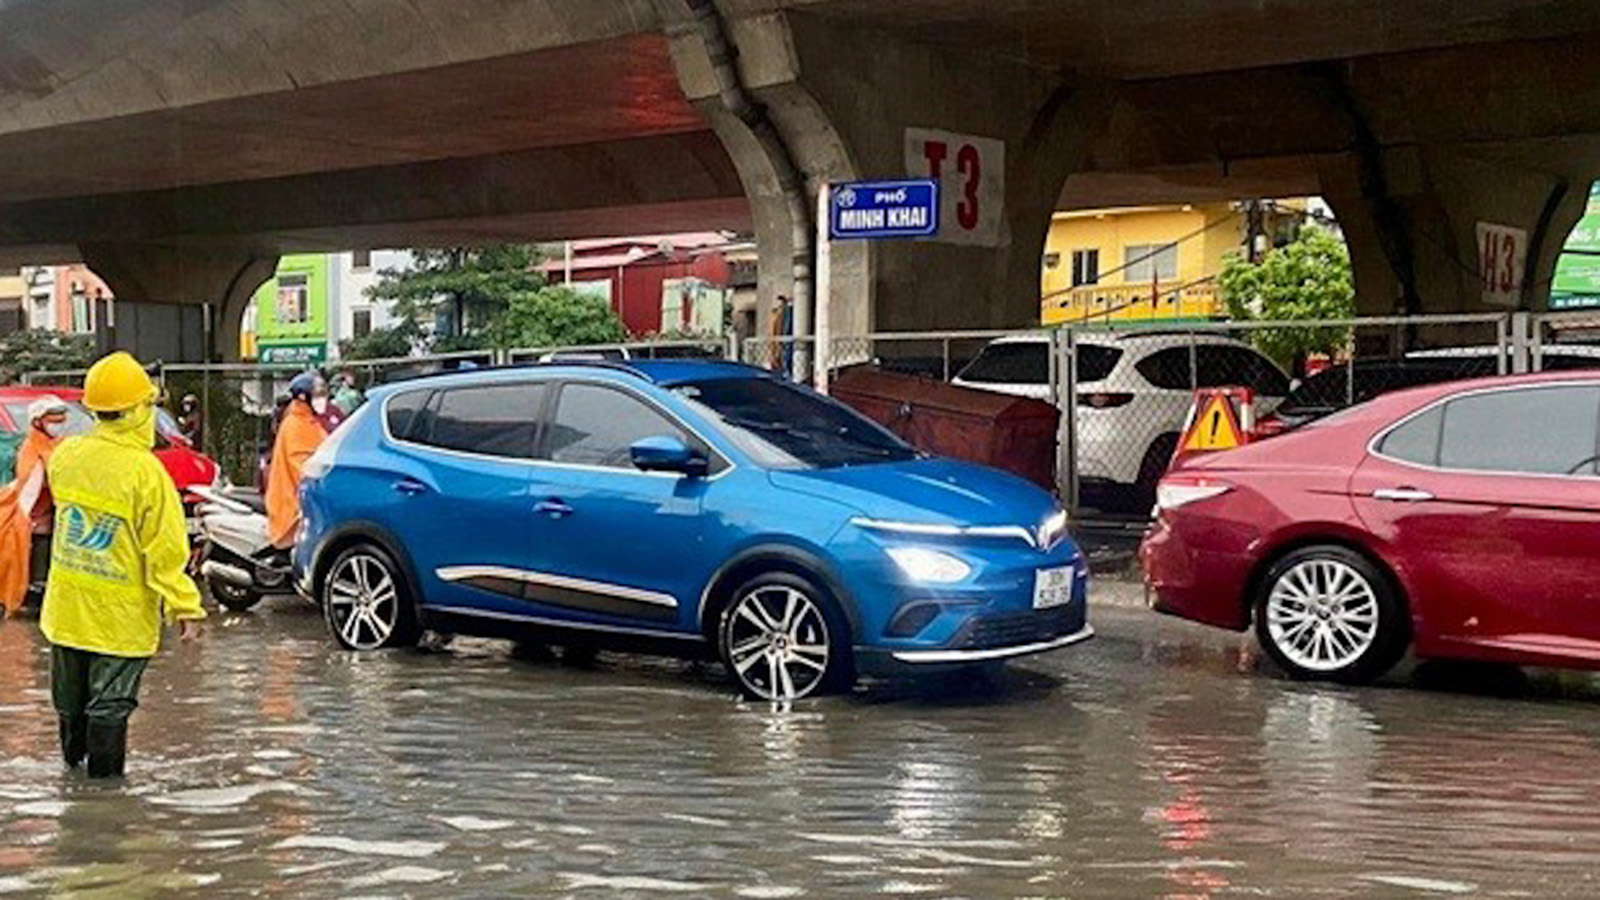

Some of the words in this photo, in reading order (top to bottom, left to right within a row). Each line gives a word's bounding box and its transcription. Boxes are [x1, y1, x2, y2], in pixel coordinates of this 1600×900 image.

[874, 187, 908, 204] PHỐ
[840, 209, 884, 229] MINH
[887, 207, 928, 227] KHAI
